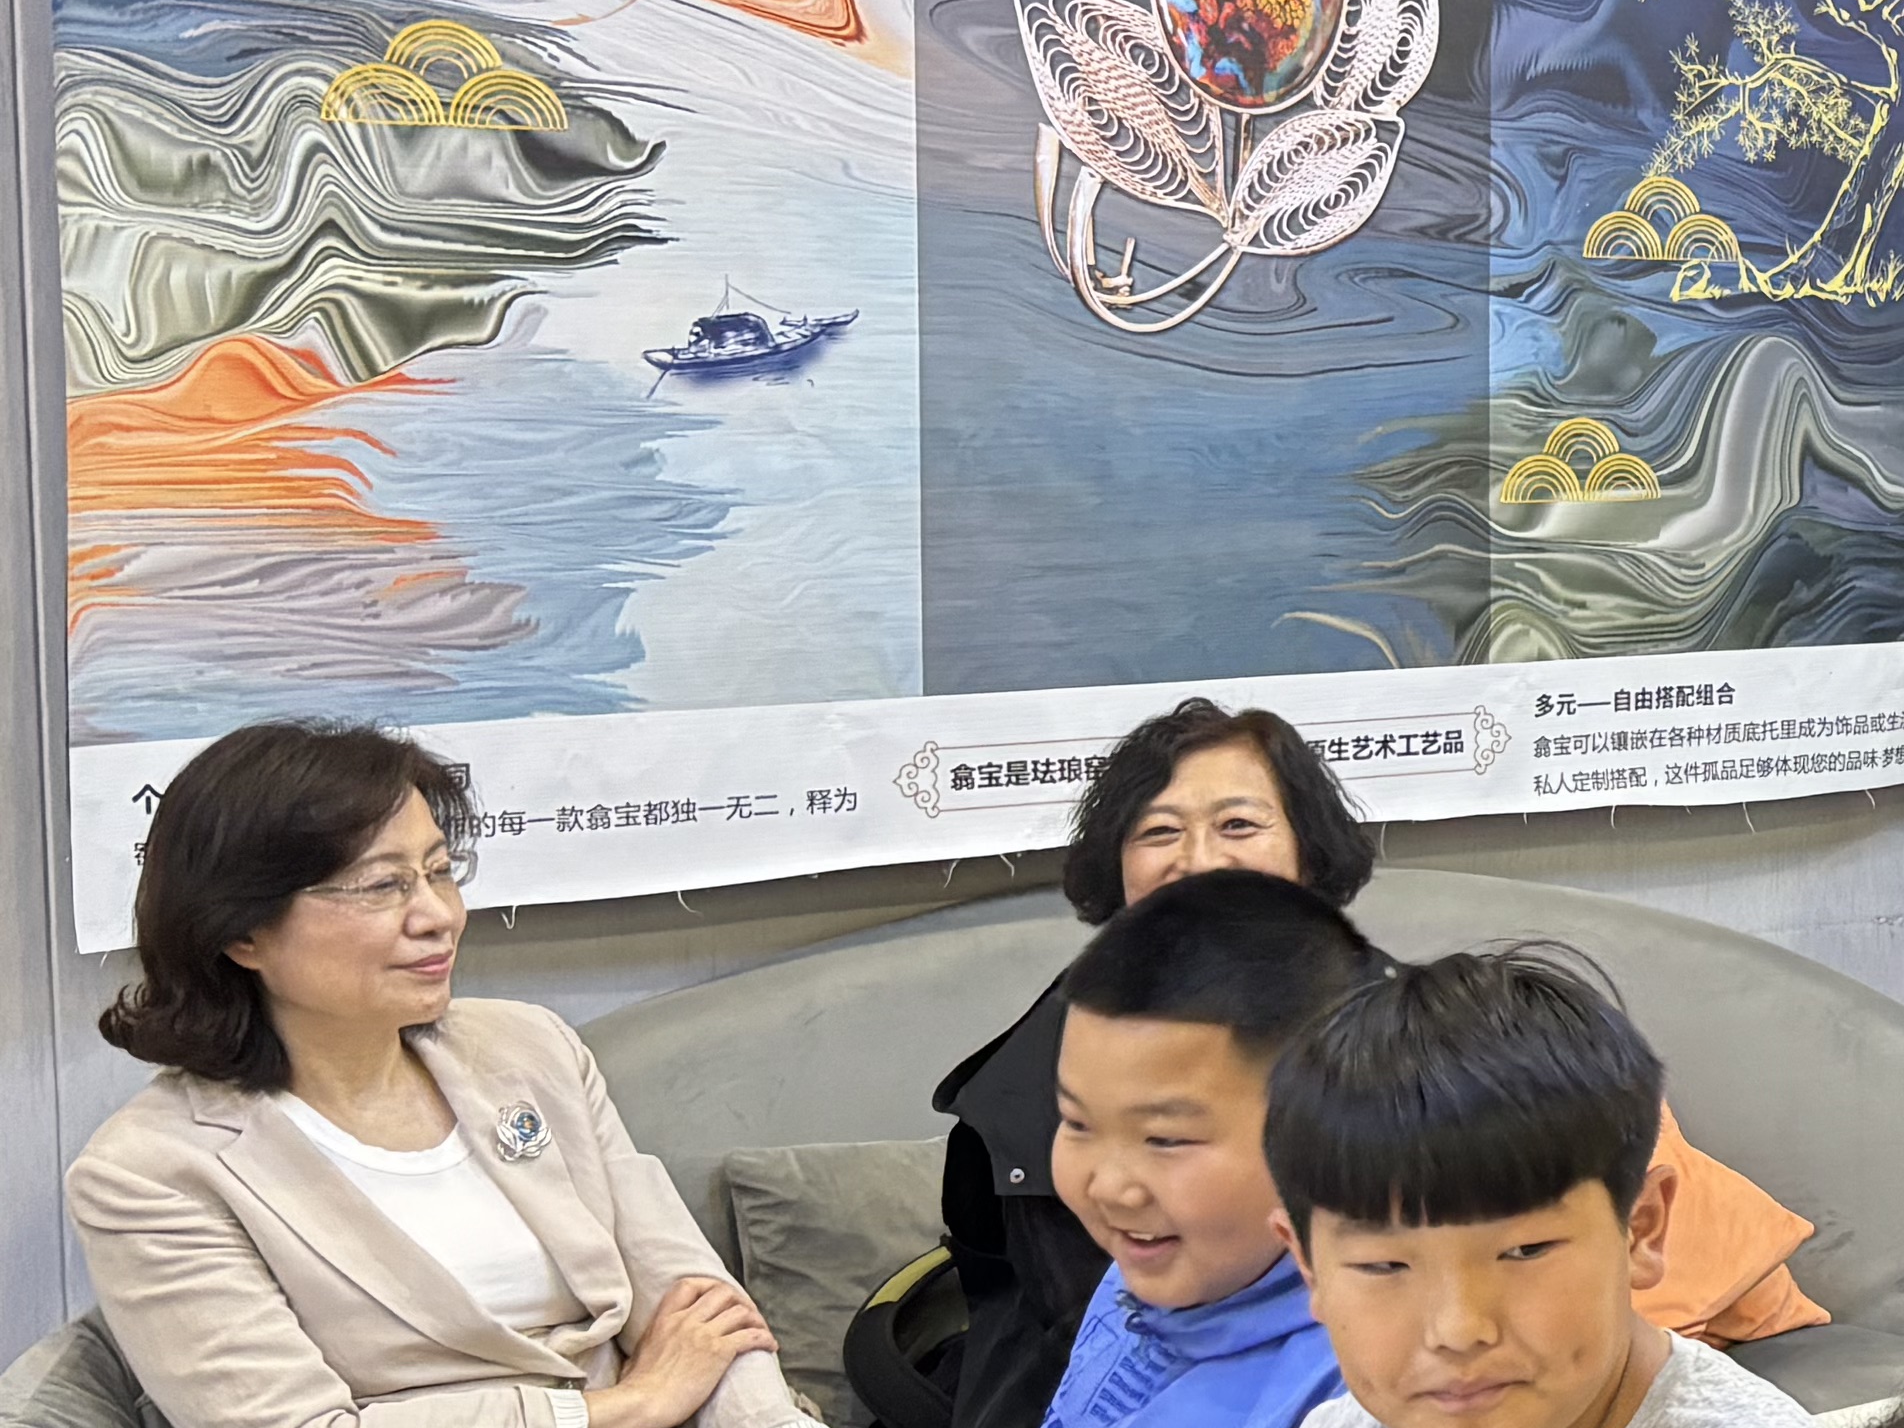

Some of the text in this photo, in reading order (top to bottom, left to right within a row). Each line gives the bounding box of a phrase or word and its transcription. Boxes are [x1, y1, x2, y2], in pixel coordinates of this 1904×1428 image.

[1533, 682, 1736, 718] 多元——自由搭配组合
